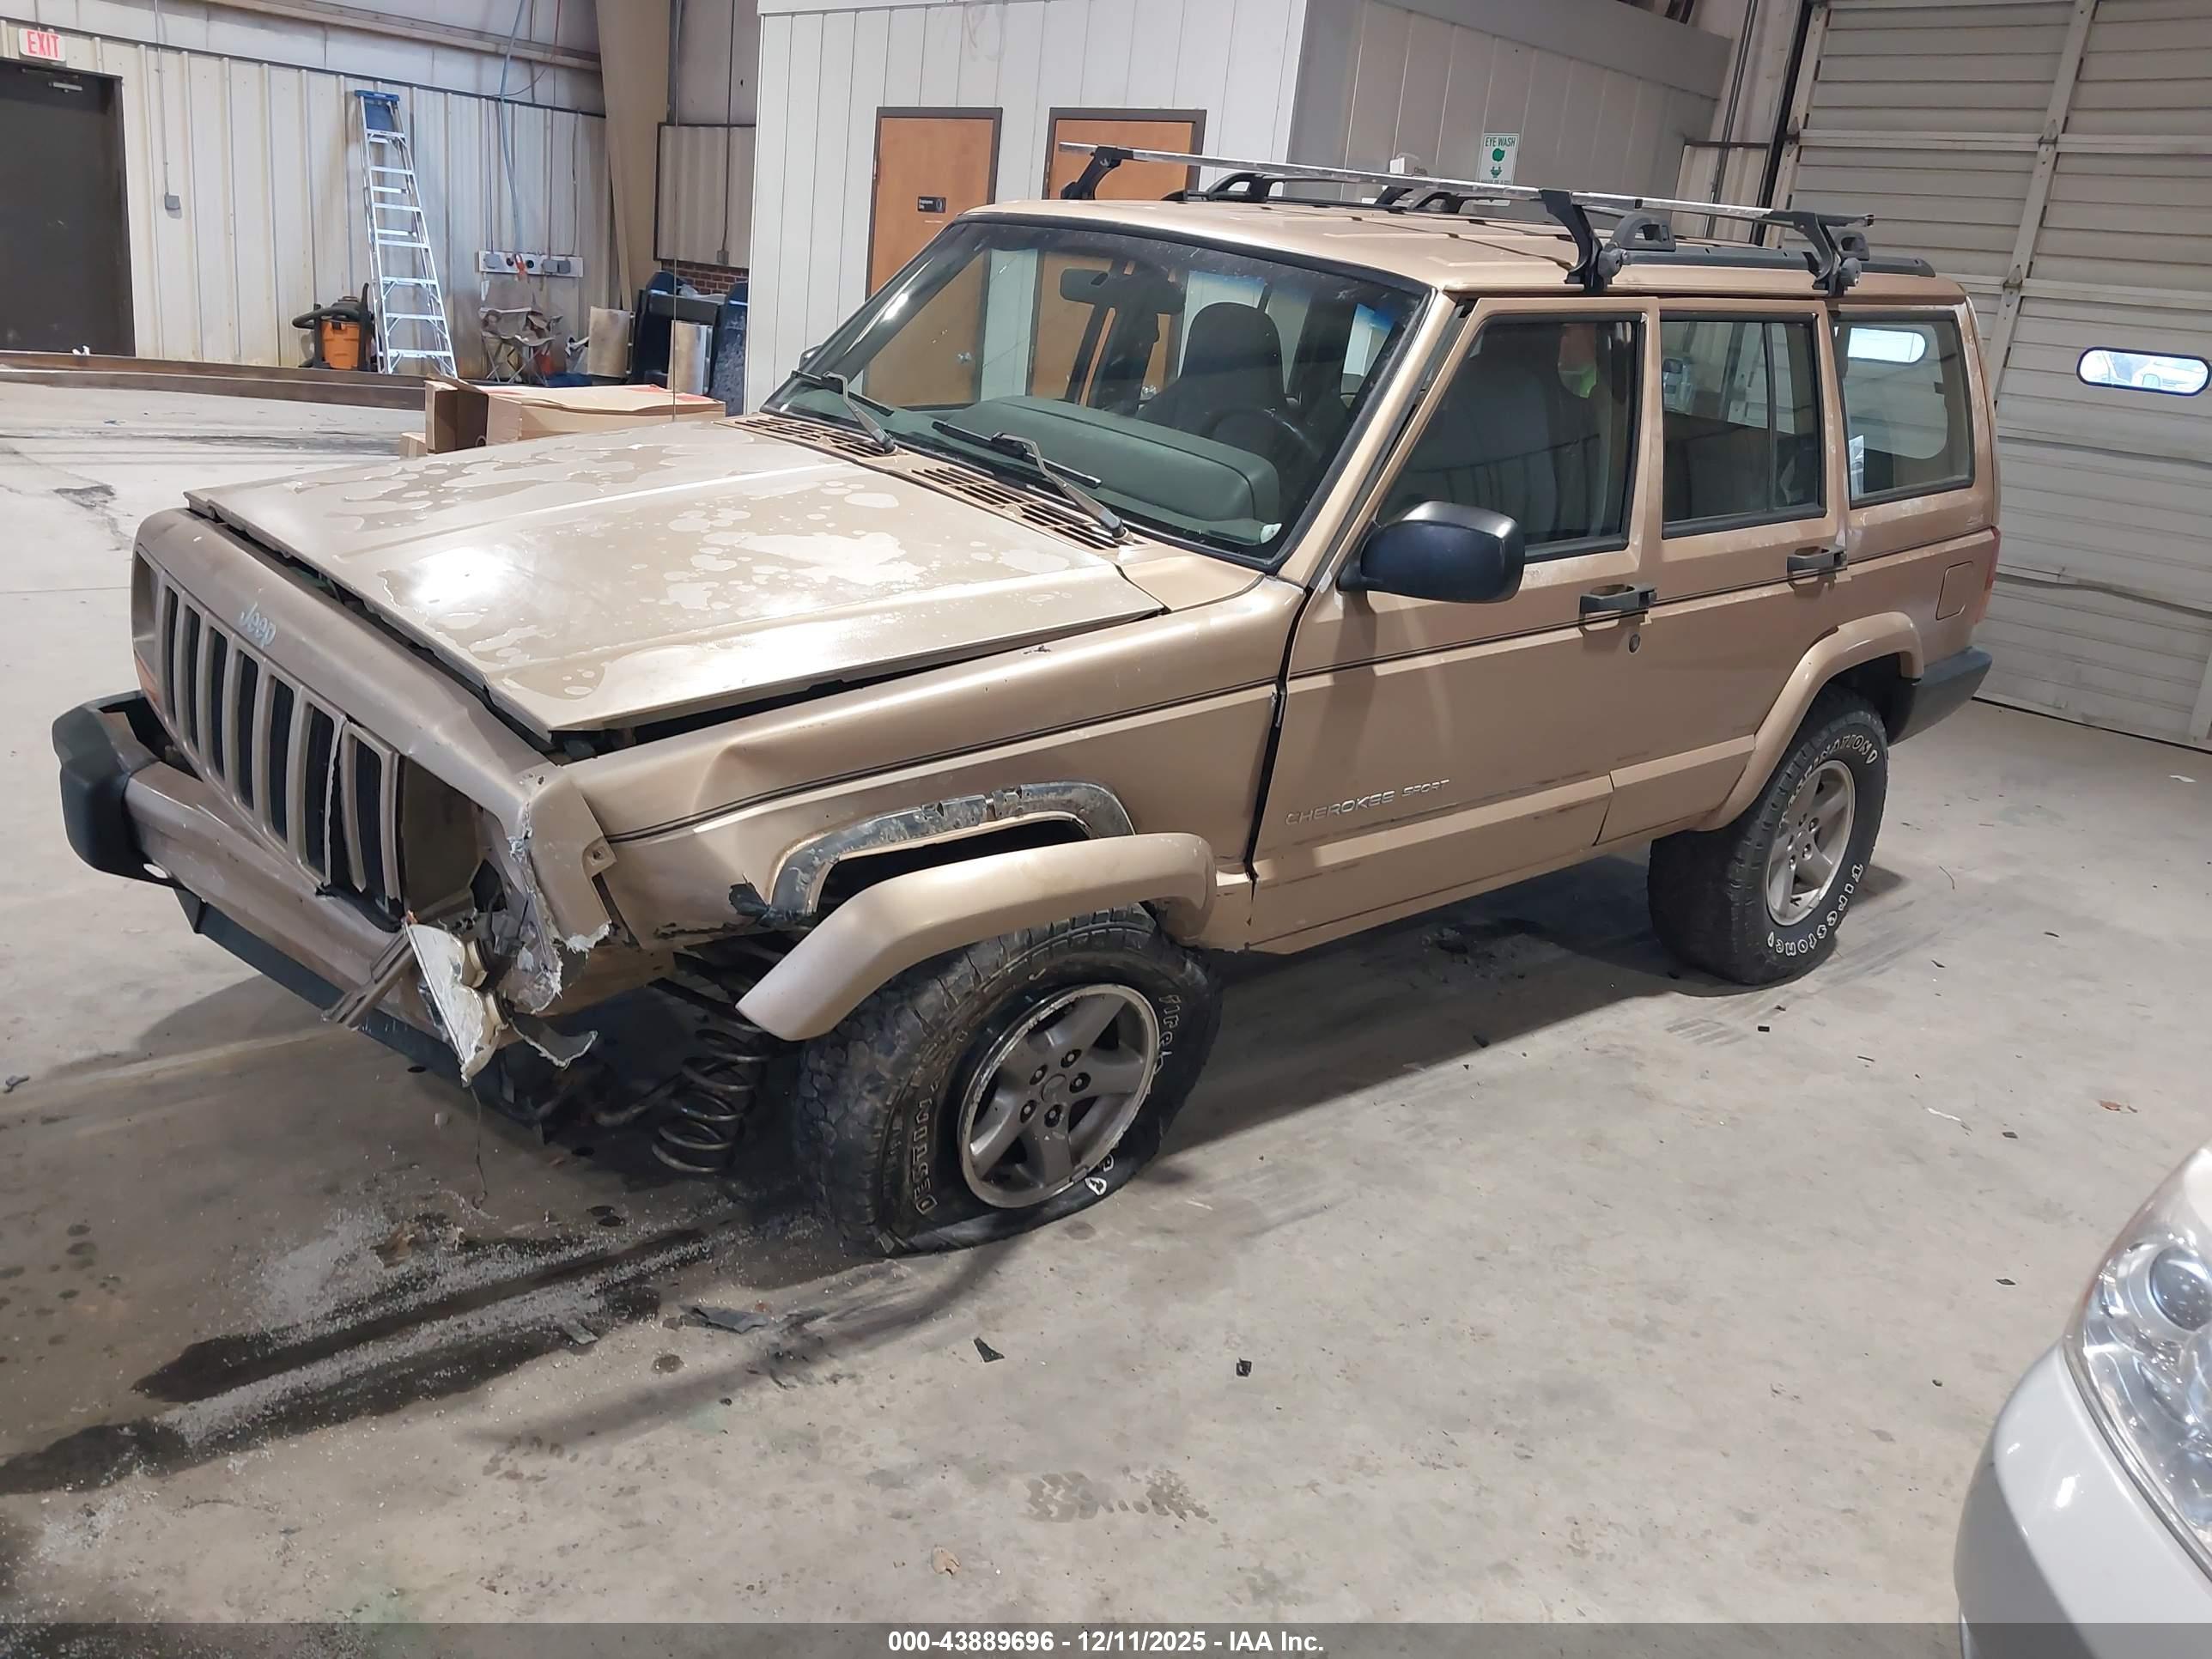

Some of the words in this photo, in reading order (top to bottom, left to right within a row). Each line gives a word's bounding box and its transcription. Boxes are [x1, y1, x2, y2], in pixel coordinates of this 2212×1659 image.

[27, 30, 60, 58] EXIT
[1485, 137, 1498, 147] EYE
[1498, 137, 1516, 147] WASH
[240, 601, 276, 649] Jeep
[1285, 789, 1395, 826] CHEROKEE
[1401, 778, 1450, 798] SPORT
